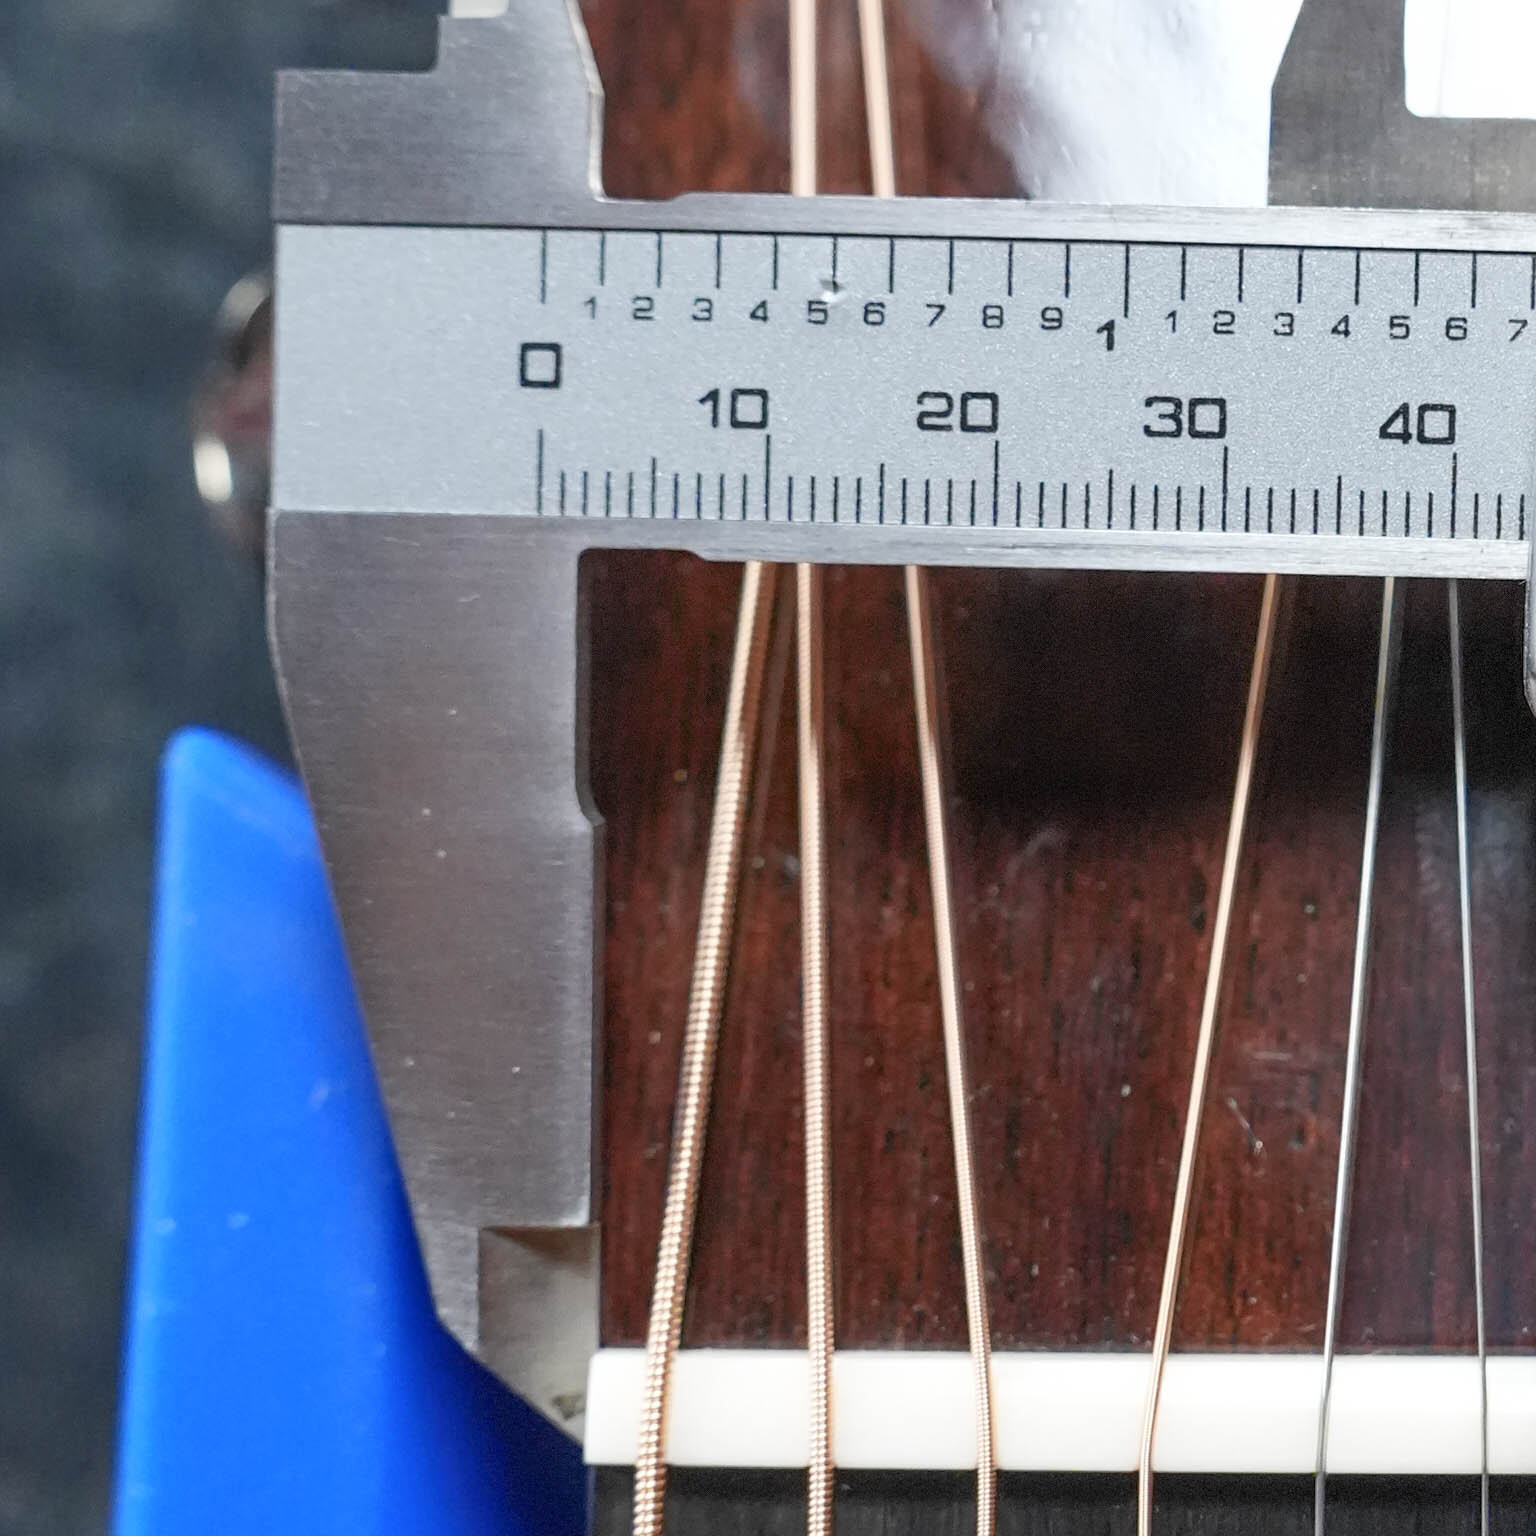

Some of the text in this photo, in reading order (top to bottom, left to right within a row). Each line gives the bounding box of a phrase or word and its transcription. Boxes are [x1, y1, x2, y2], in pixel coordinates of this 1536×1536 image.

[583, 297, 1528, 351] 1 2 3 4 5 6 7 8 9 1 1 2 3 4 5 6 7
[520, 343, 1456, 444] 0 10 20 30 40
